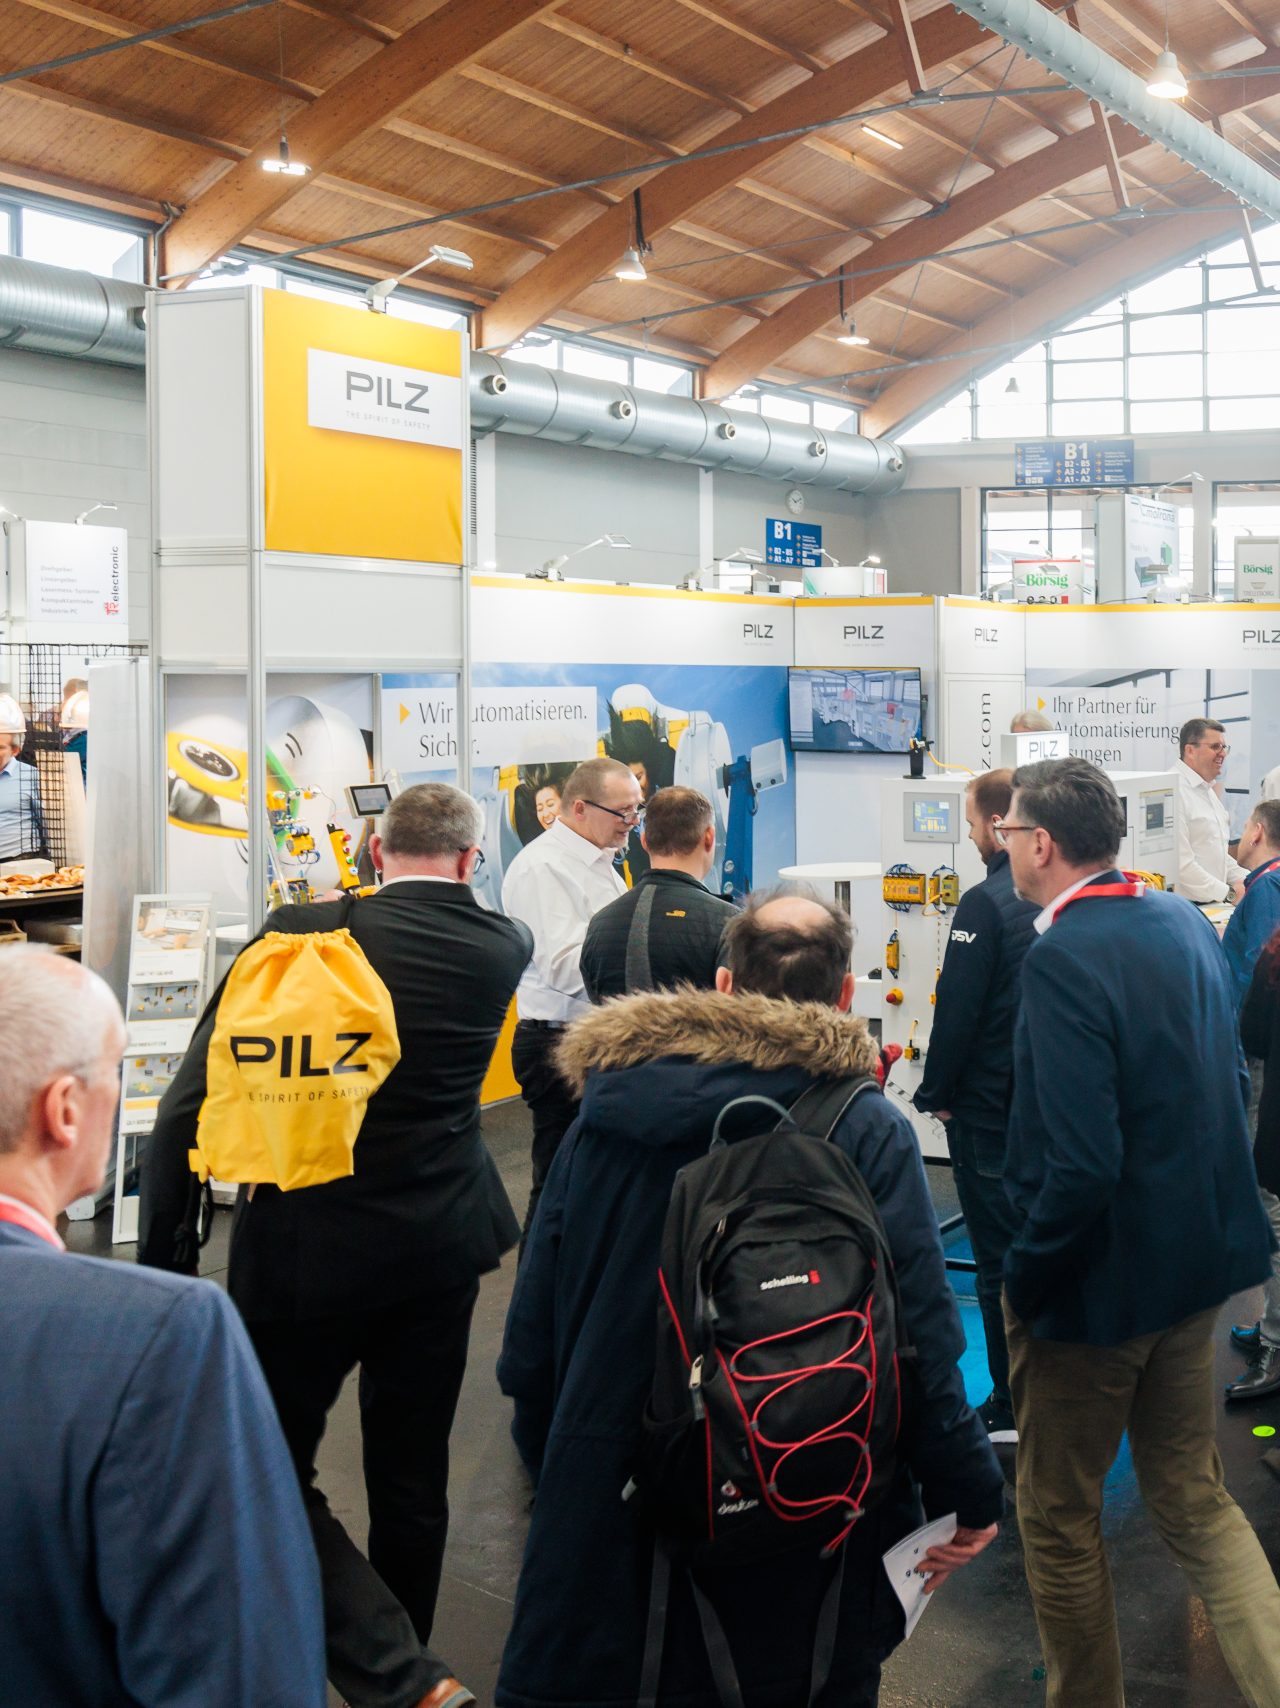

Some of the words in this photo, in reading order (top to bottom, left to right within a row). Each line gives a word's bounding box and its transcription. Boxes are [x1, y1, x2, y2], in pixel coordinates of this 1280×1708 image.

[346, 370, 430, 414] PILZ
[346, 411, 360, 419] THE
[364, 414, 388, 424] SPIRIT
[404, 419, 431, 431] SAFETY
[1064, 442, 1088, 460] B1
[1064, 460, 1074, 468] B2
[773, 521, 792, 540] B1
[110, 546, 119, 602] electronic
[1243, 564, 1273, 575] Börsig
[1026, 573, 1069, 589] Börsig
[743, 623, 774, 639] PILZ
[843, 625, 884, 639] PILZ
[975, 628, 998, 642] PILZ
[419, 701, 453, 724] Wir
[471, 699, 587, 723] utomatisieren.
[1053, 696, 1074, 714] Ihr
[1078, 696, 1132, 714] Partner
[1135, 695, 1157, 714] für
[419, 732, 480, 758] Sichr.
[1028, 740, 1059, 759] PILZ
[1069, 748, 1122, 765] sungen
[230, 1032, 373, 1078] PILZ
[308, 1091, 325, 1101] OF
